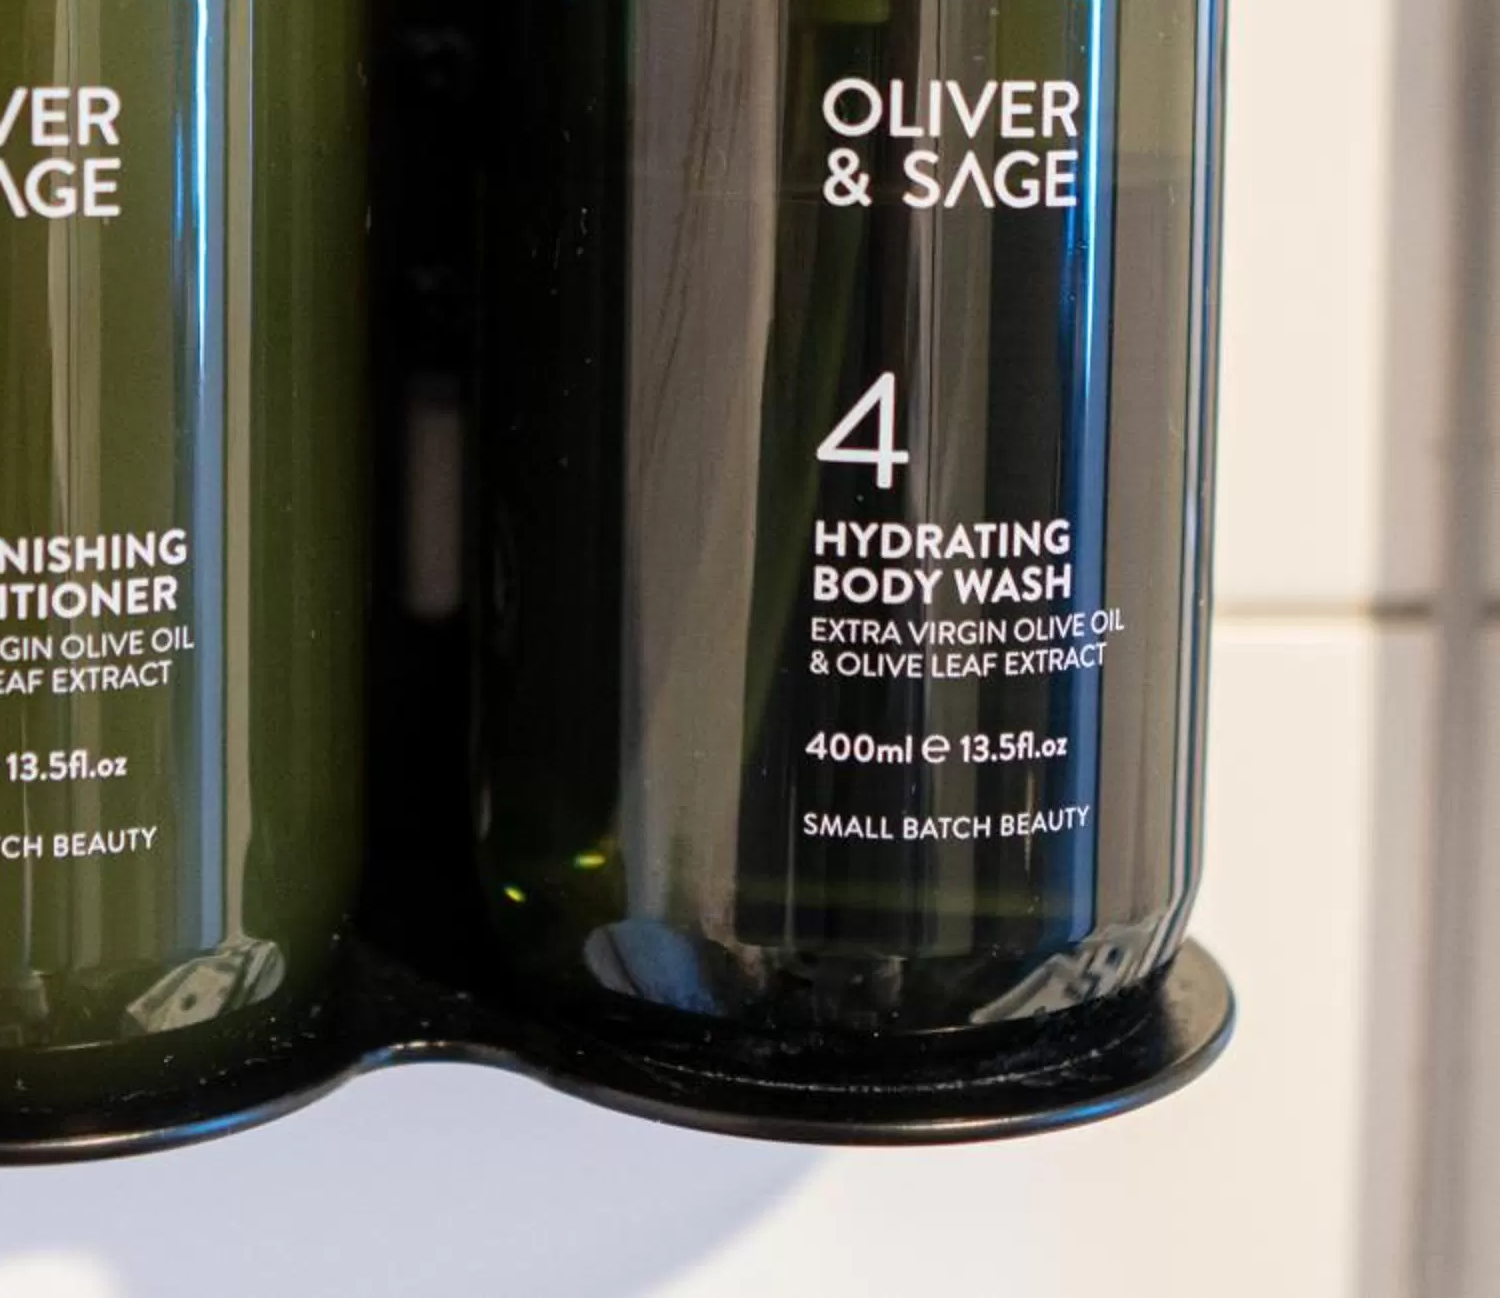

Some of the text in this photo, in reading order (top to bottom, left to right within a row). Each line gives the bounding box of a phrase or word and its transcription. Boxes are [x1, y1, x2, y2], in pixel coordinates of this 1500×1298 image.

[822, 78, 1080, 138] OLIVER
[823, 147, 872, 206] &
[816, 371, 909, 489] 4
[814, 520, 1072, 559] HYDRATING
[813, 564, 1072, 604] BODY WASH
[61, 631, 144, 660] OLIVE
[151, 627, 194, 653] OIL
[811, 609, 1124, 646] EXTRA VIRGIN OLIVE OIL
[52, 660, 173, 693] EXTRACT
[809, 643, 1108, 679] & OLIVE LEAF EXTRACT
[6, 750, 128, 782] 13.5fl.oz
[805, 732, 912, 764] 400ml
[960, 732, 1067, 763] 13.5fl.oz
[803, 806, 1090, 840] SMALL BATCH BEAUTY
[53, 826, 157, 858] BEAUTY
